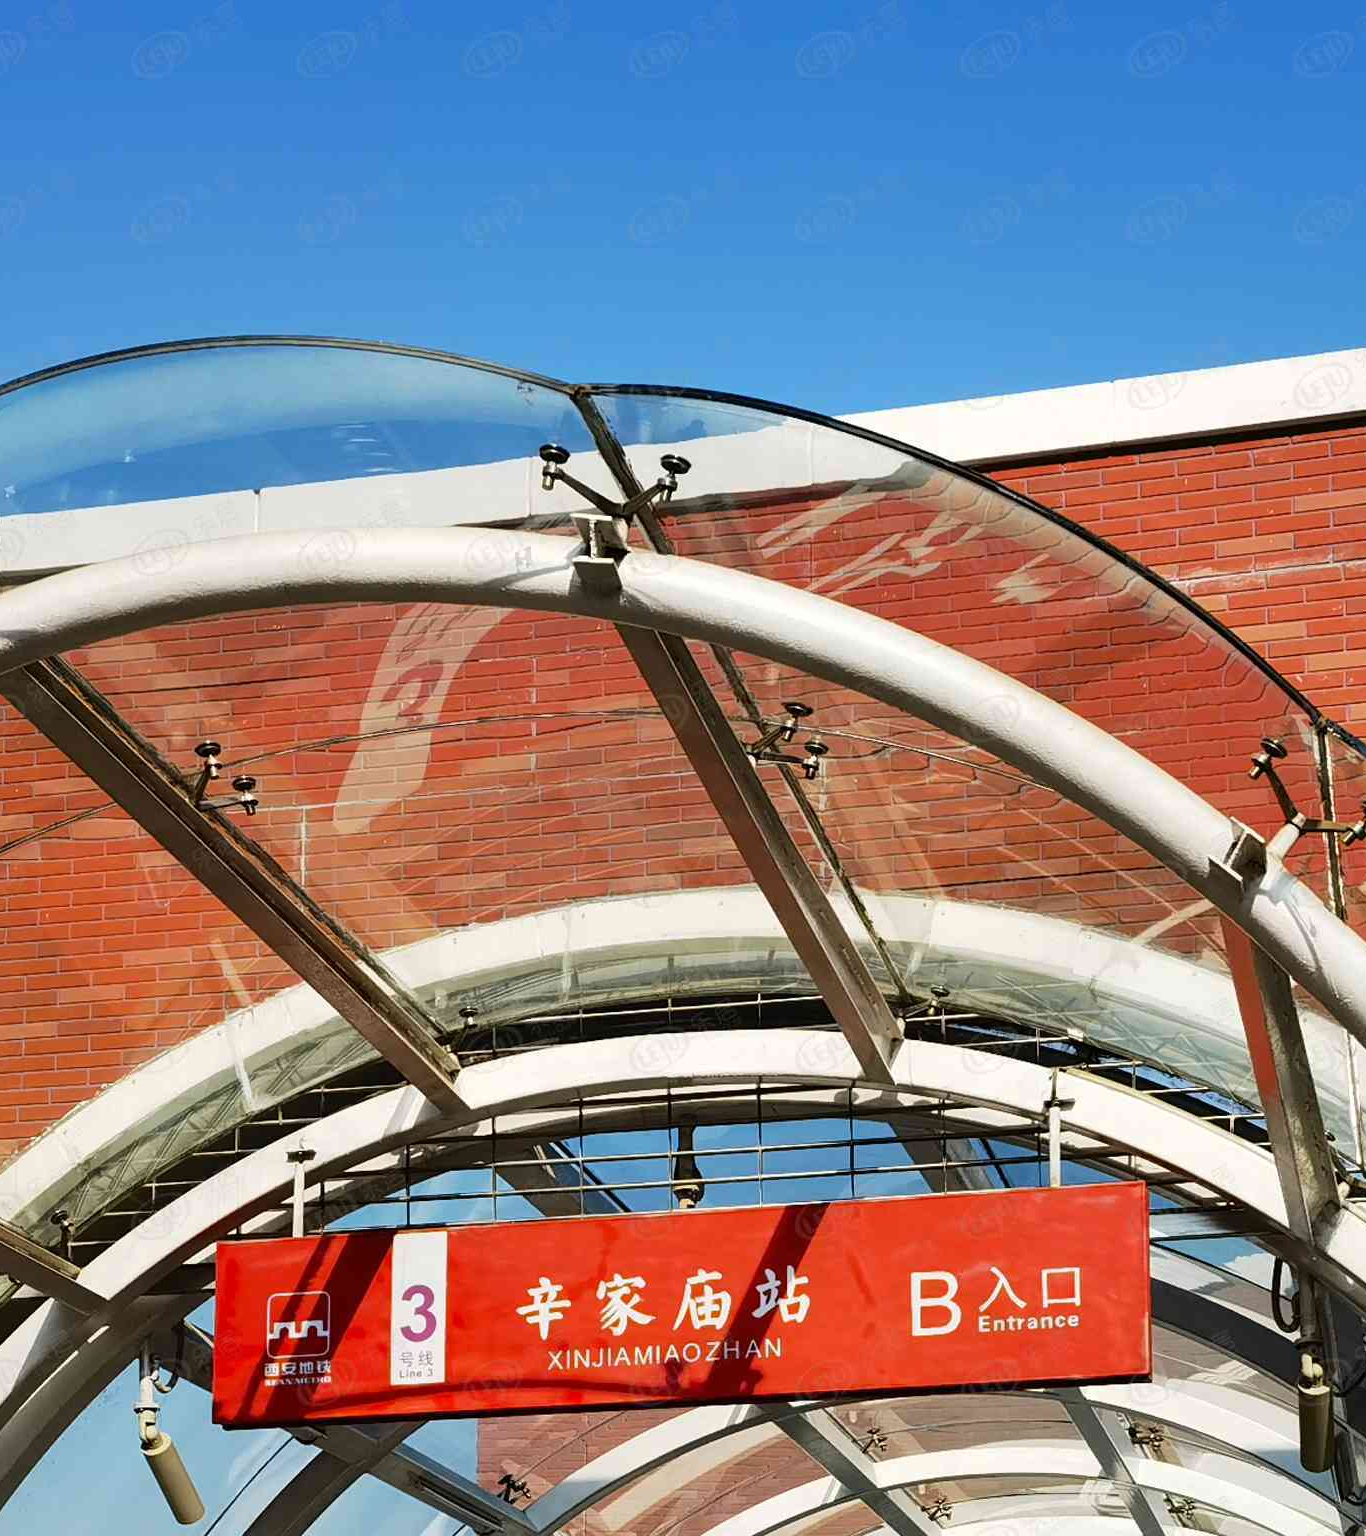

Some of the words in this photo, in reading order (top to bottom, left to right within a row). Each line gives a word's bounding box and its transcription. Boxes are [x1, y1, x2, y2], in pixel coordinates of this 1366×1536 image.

[516, 1265, 811, 1340] 辛家庙站
[911, 1271, 962, 1336] B
[979, 1266, 1081, 1312] 入口
[400, 1285, 437, 1342] 3
[978, 1315, 1080, 1333] Entrance
[264, 1360, 331, 1377] 西安地铁
[400, 1350, 434, 1367] 号线
[547, 1337, 782, 1370] XINJIAMIAOZHAN
[399, 1369, 423, 1379] Line
